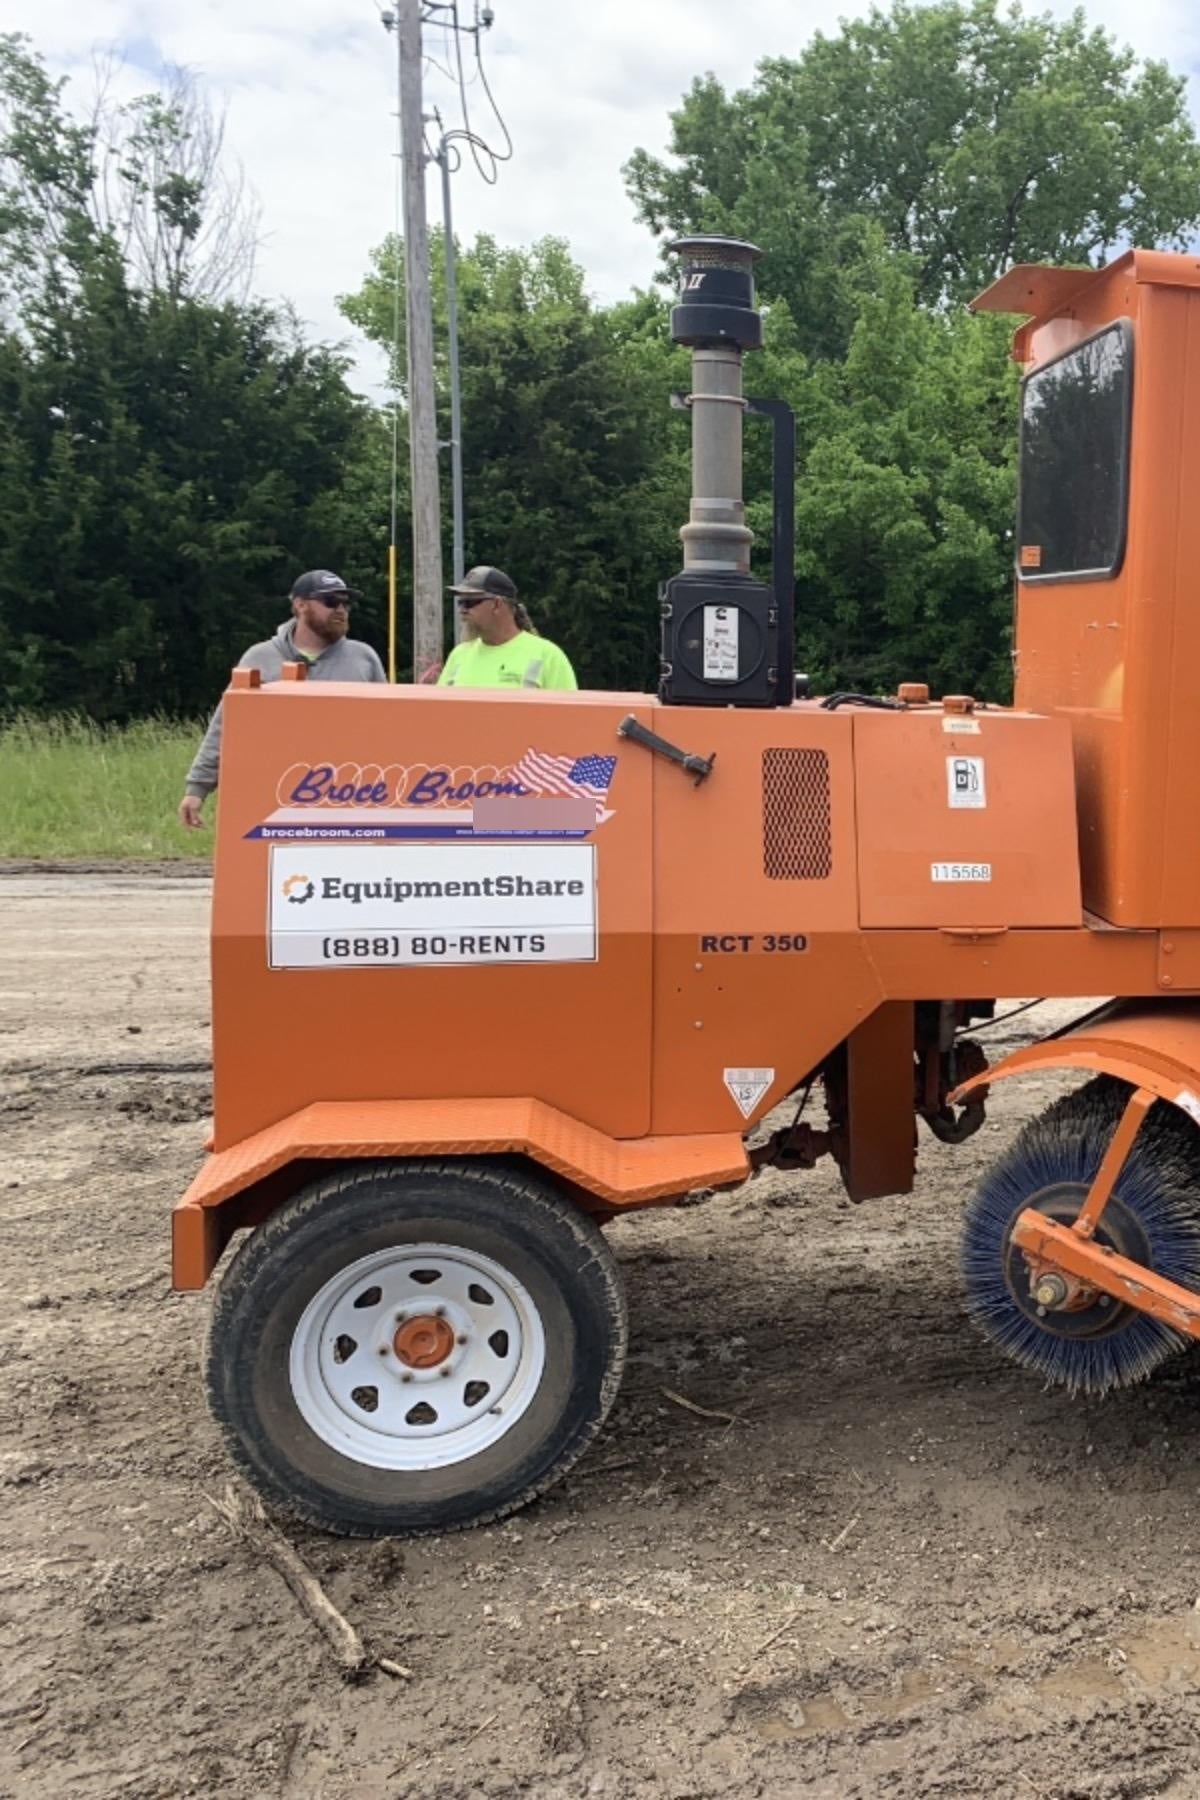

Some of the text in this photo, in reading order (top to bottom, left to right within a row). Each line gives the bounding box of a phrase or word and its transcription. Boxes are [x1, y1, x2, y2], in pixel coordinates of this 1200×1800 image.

[290, 767, 531, 804] Broce Broom
[261, 827, 386, 838] brocebroom.com
[932, 865, 990, 880] 115568
[321, 874, 584, 902] EquipmentShare
[322, 934, 546, 959] (888) 80-RENTS
[701, 935, 807, 952] RCT 350
